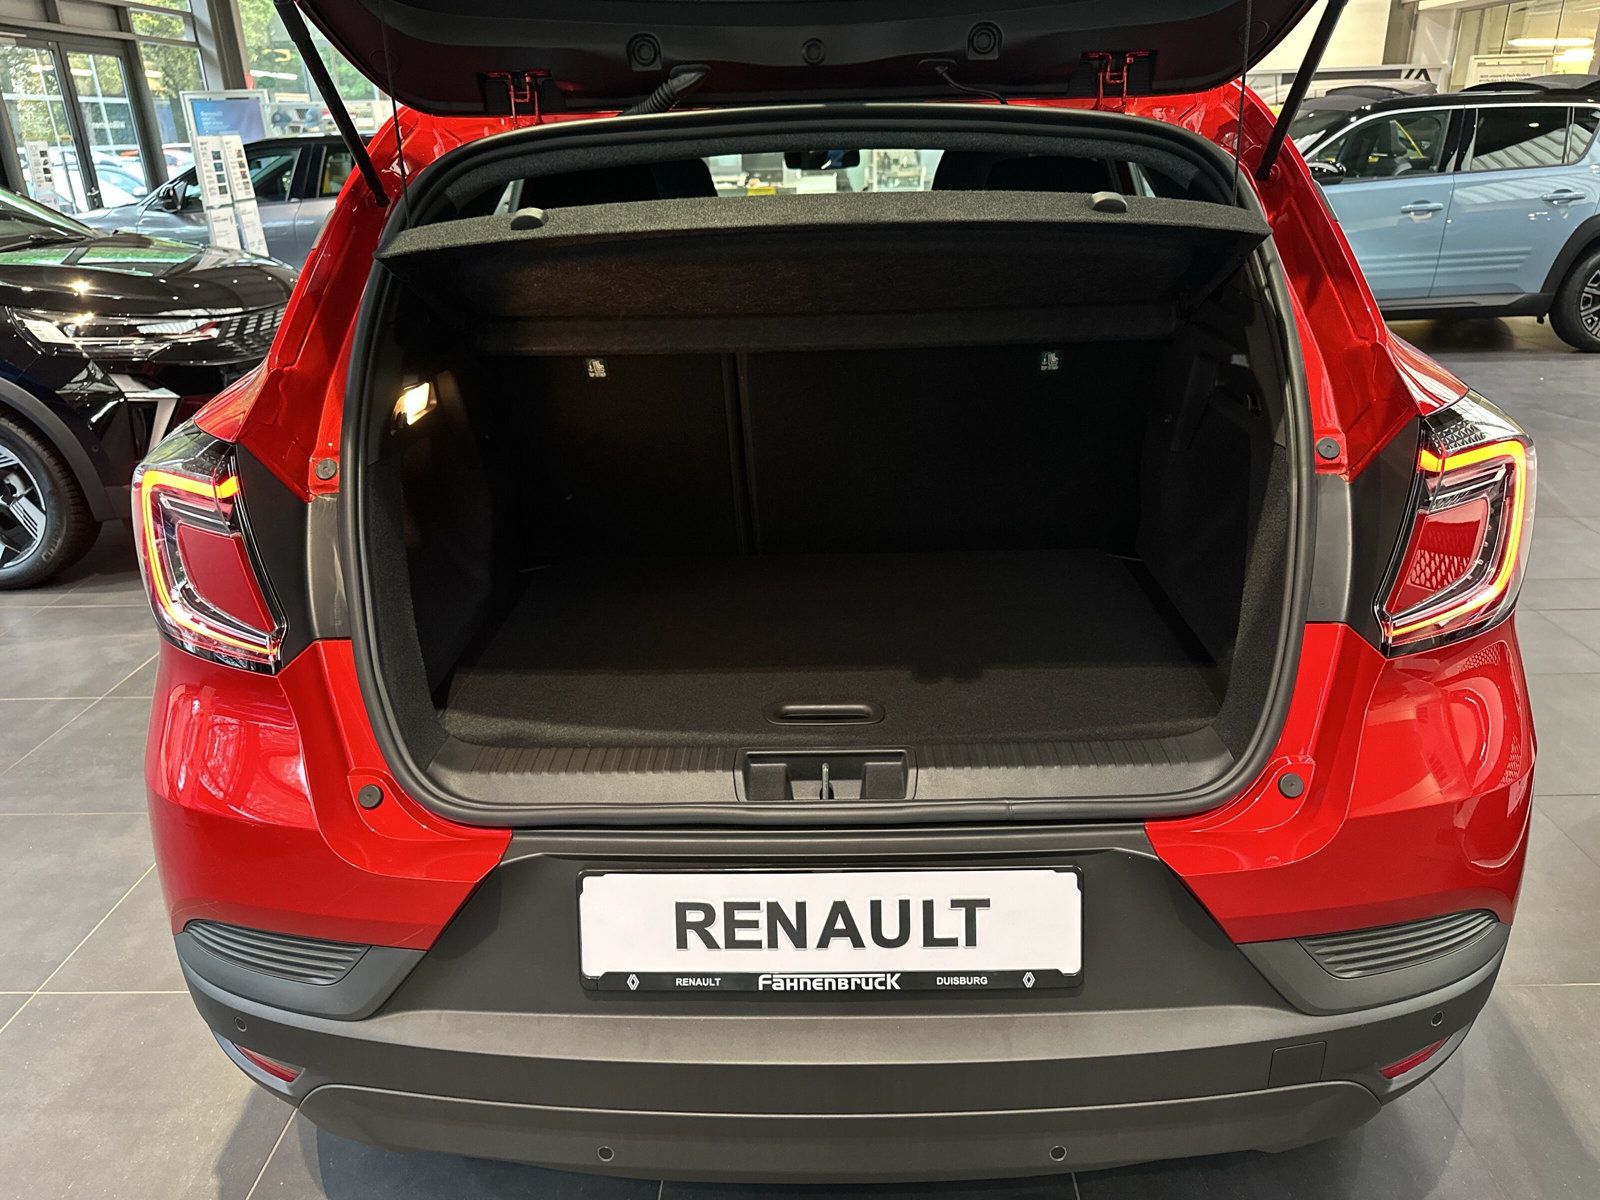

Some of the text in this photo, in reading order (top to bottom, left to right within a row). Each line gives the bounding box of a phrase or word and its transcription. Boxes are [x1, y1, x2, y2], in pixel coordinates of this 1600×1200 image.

[675, 897, 991, 950] RENAULT
[675, 977, 722, 987] RENAULT
[936, 976, 989, 986] DUISBURG
